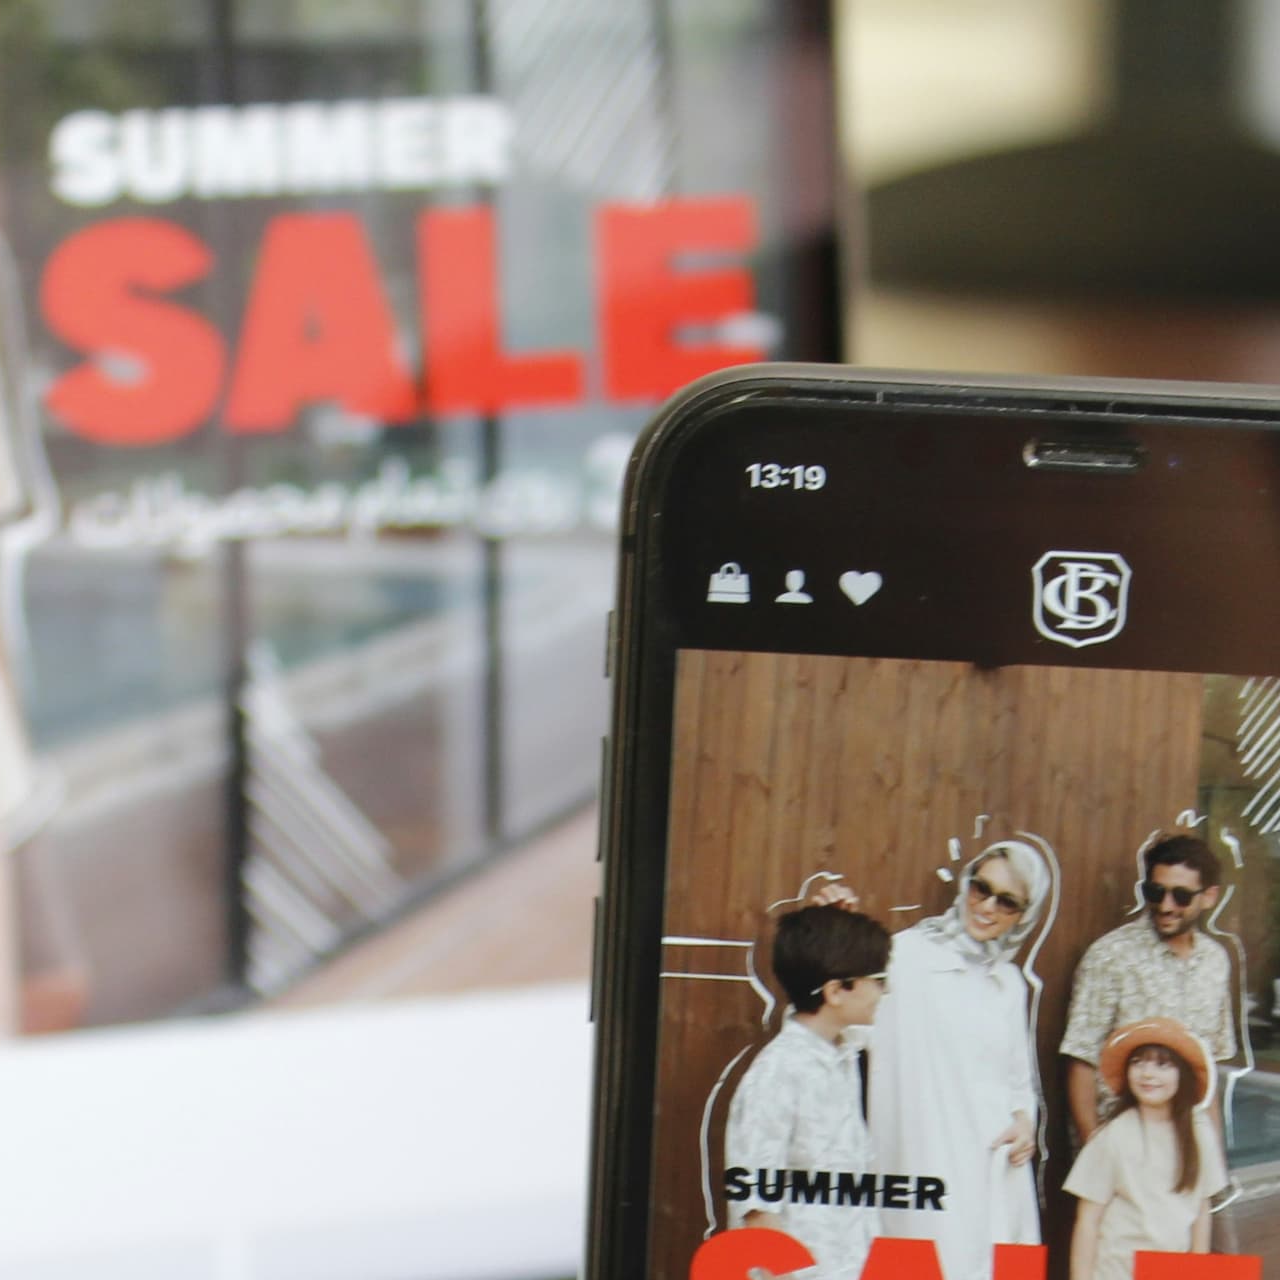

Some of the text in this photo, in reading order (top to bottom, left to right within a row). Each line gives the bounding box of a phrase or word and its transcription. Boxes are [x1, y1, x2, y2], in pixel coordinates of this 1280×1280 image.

[50, 97, 512, 204] SUMMER
[40, 195, 765, 446] SALE
[745, 463, 827, 491] 13:19
[724, 1166, 946, 1211] SUMMER
